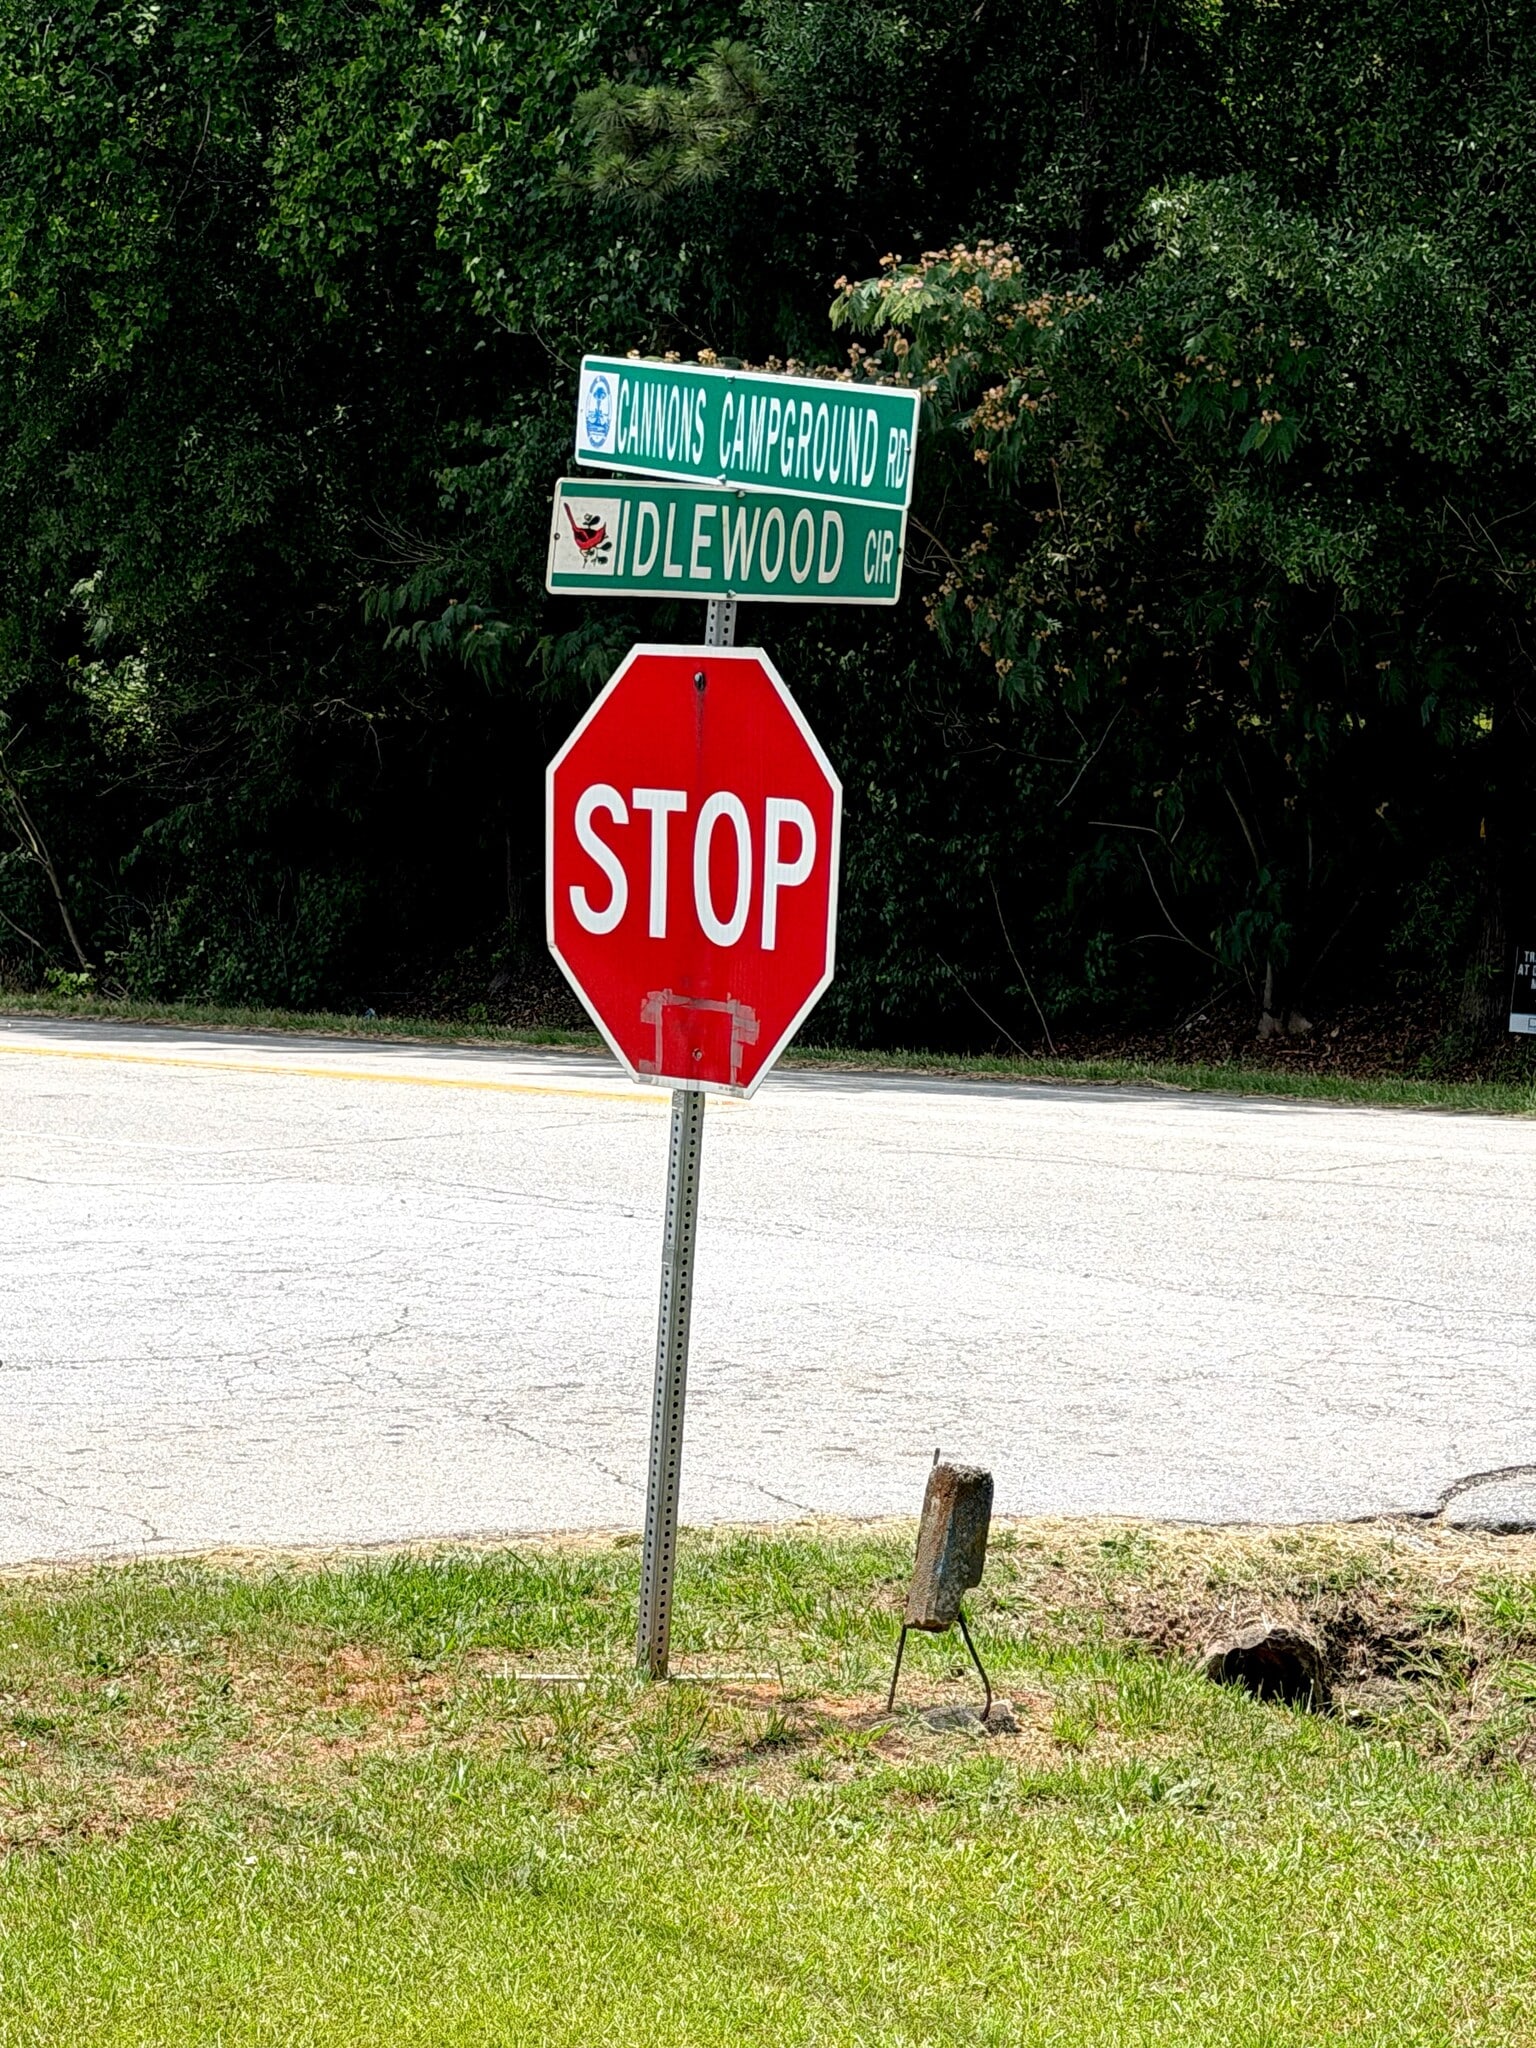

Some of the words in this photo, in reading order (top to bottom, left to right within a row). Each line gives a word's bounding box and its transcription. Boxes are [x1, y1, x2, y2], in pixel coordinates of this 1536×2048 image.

[616, 378, 706, 465] CANNONS
[719, 391, 879, 487] CAMPGROUND
[884, 427, 908, 488] RD
[617, 500, 844, 584] IDLEWOOD
[863, 529, 894, 584] CIR
[569, 783, 817, 951] STOP
